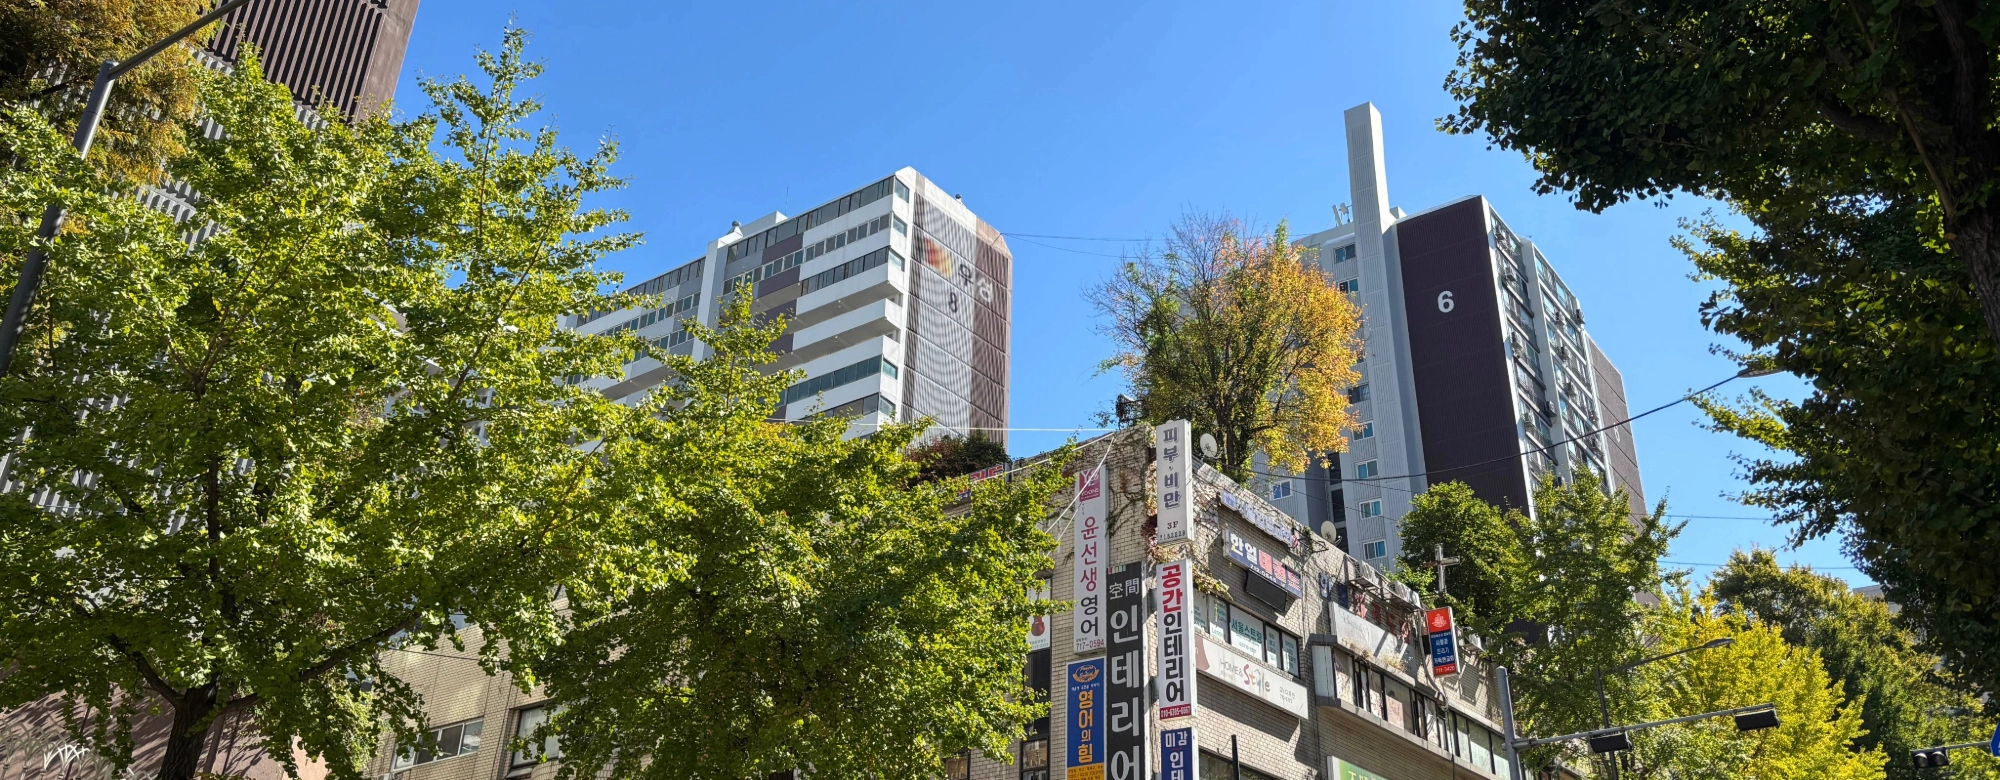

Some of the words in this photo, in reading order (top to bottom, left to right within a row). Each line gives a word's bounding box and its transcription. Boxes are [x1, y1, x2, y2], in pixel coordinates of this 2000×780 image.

[949, 291, 958, 313] 8
[1438, 290, 1454, 313] 6
[1167, 520, 1179, 530] 3F
[1109, 577, 1140, 600] 空間
[1231, 618, 1263, 644] 서울스트링
[1076, 639, 1105, 651] 717-0594
[1110, 604, 1140, 780] 인테리어
[1165, 730, 1189, 748] 미감
